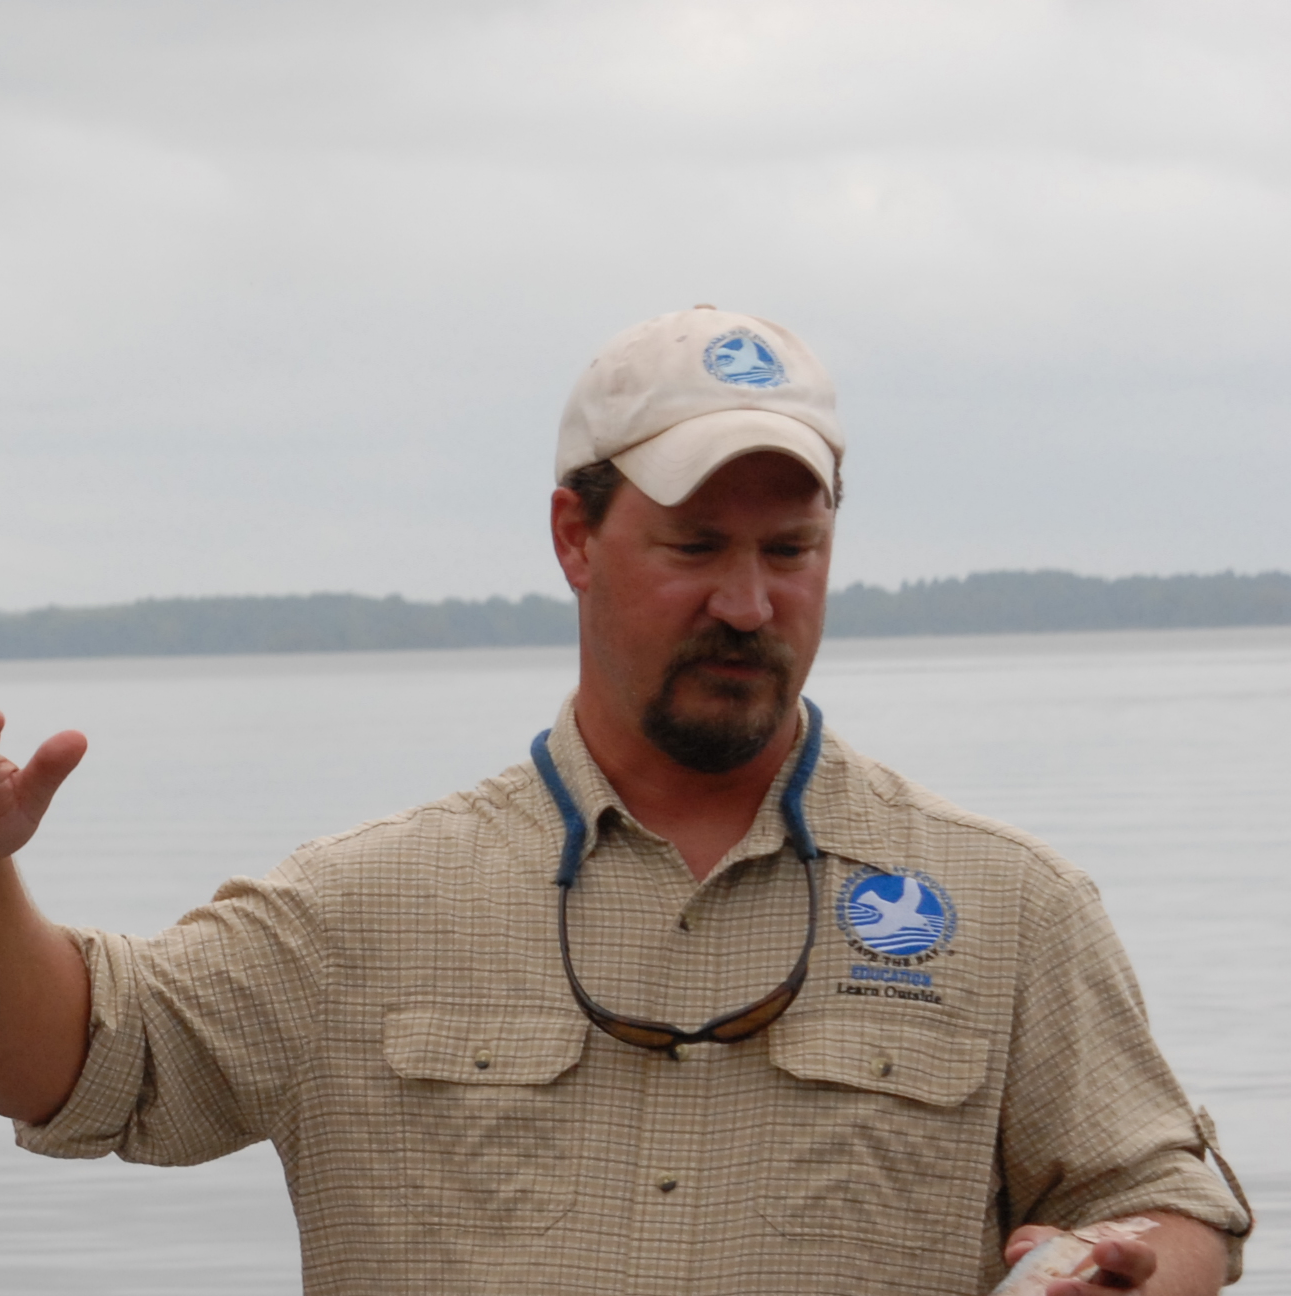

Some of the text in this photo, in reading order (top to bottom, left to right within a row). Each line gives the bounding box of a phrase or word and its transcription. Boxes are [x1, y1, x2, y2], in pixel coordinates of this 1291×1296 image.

[848, 939, 938, 967] SAVE THE BAY
[837, 982, 941, 1004] Learn Outside
